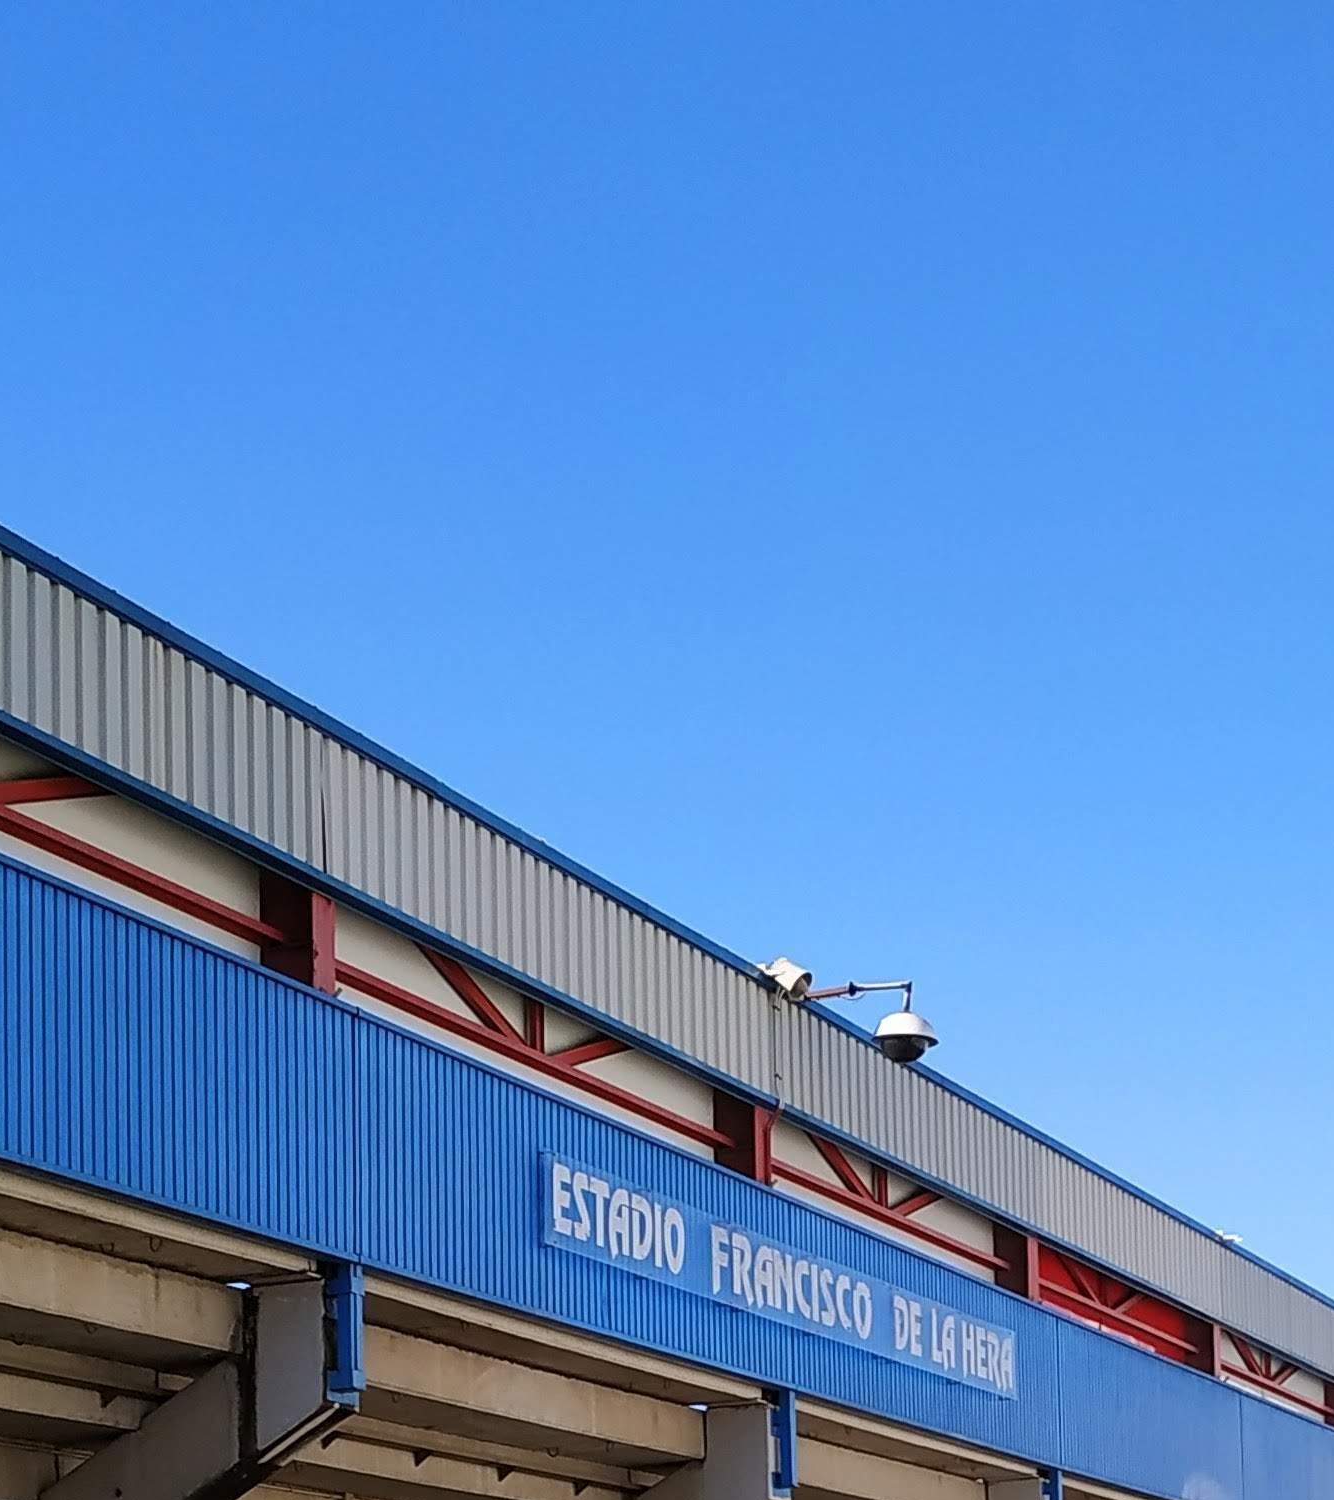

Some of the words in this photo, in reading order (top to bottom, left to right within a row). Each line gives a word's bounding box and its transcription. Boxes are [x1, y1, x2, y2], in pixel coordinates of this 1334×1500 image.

[553, 1162, 685, 1275] ESTADIO
[710, 1223, 873, 1340] FRANCISCO
[893, 1294, 923, 1357] DE
[931, 1307, 956, 1372] LA
[961, 1319, 1014, 1393] HERA
